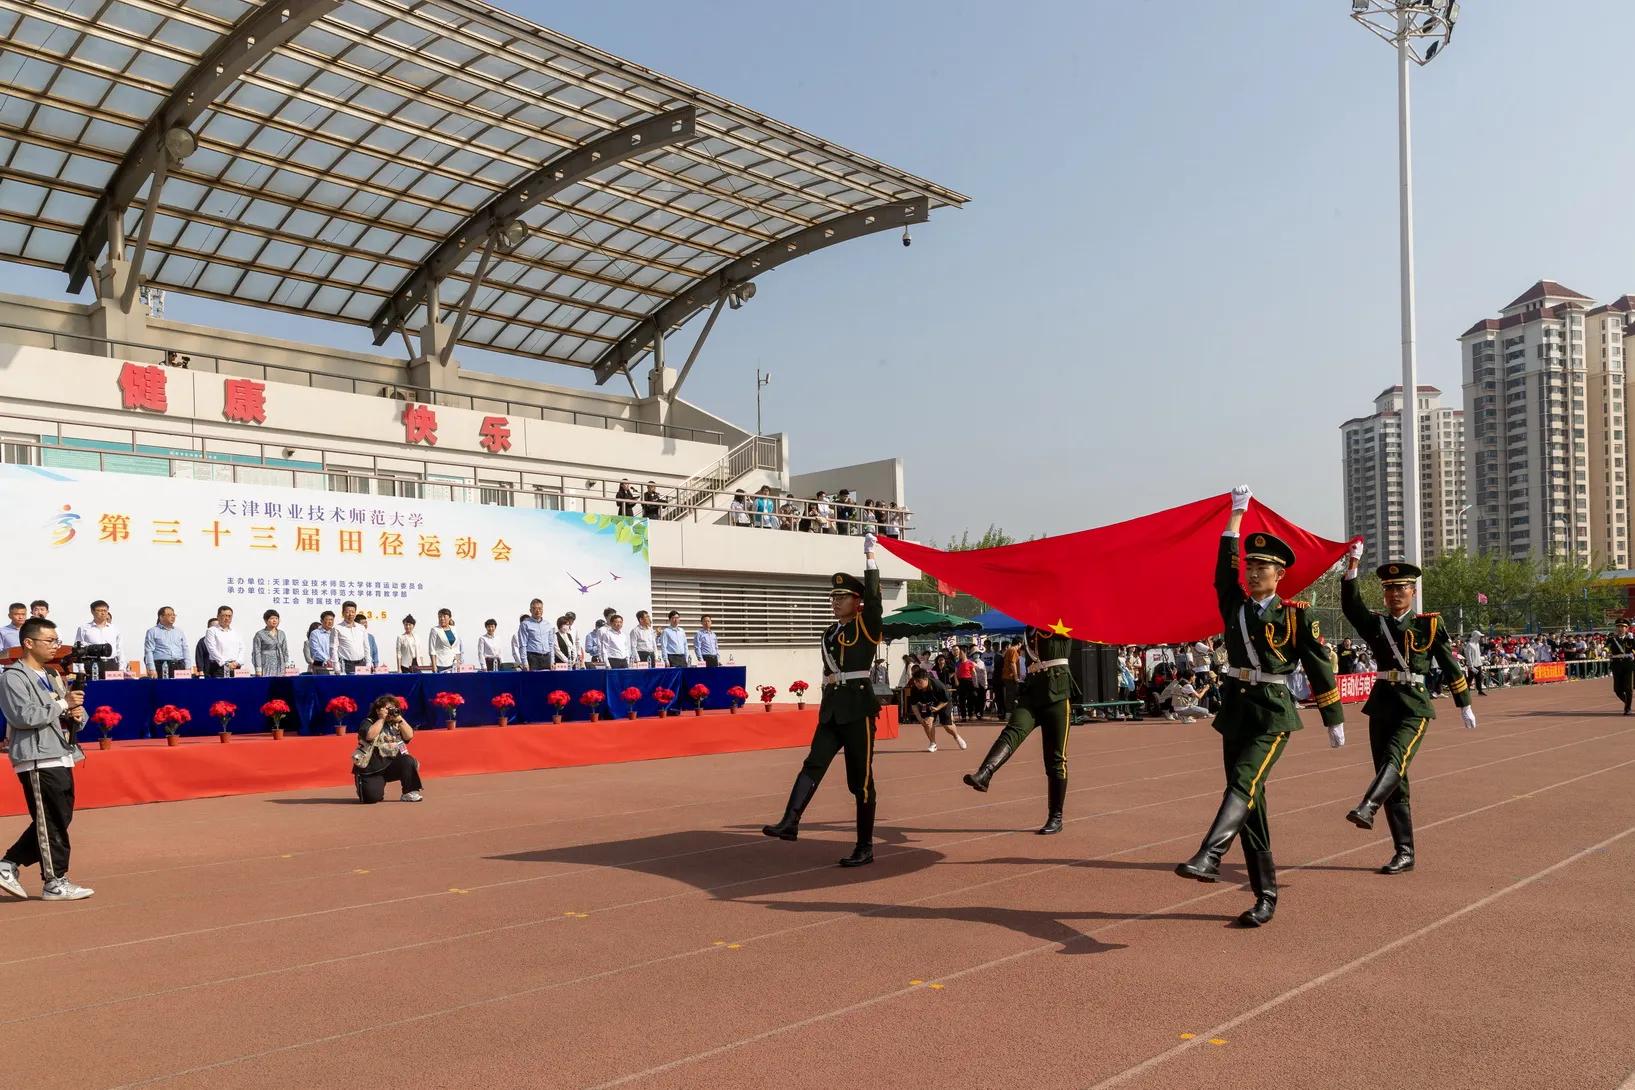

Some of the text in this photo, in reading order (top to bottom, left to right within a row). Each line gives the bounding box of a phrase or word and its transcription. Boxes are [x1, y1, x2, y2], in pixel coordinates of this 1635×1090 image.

[117, 361, 511, 453] 健康 快乐
[97, 512, 513, 562] 第三十三届田径运动会
[219, 499, 424, 528] 天津职业技术师范大学
